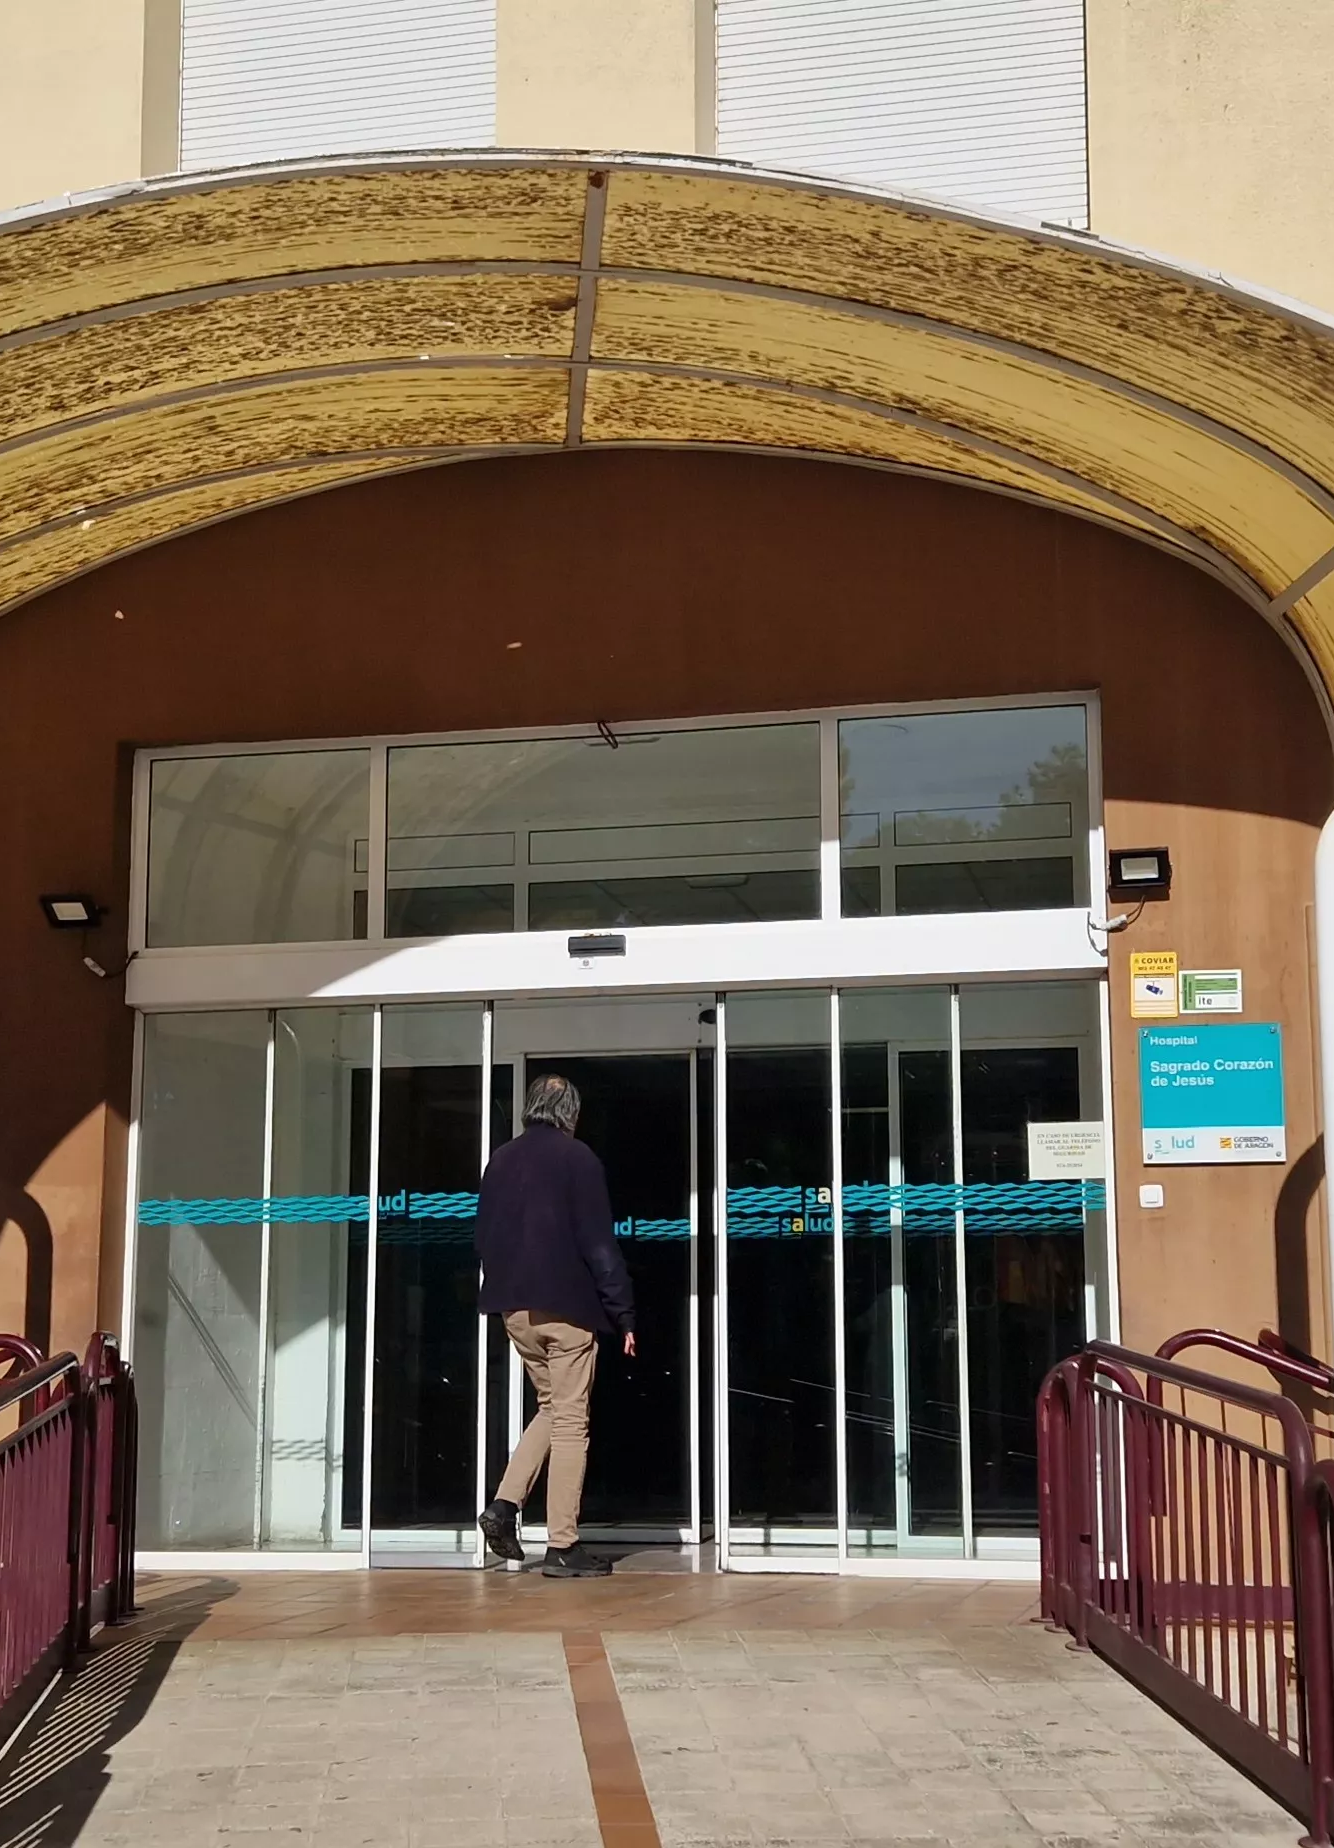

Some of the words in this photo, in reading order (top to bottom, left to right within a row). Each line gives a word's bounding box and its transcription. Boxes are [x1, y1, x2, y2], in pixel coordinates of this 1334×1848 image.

[1198, 996, 1212, 1006] ite
[1150, 1036, 1198, 1046] Hospital
[1150, 1060, 1210, 1074] Sagrado
[1213, 1058, 1274, 1071] Corazón
[1151, 1076, 1168, 1087] de
[1172, 1074, 1214, 1086] Jesús
[1154, 1136, 1195, 1149] slud
